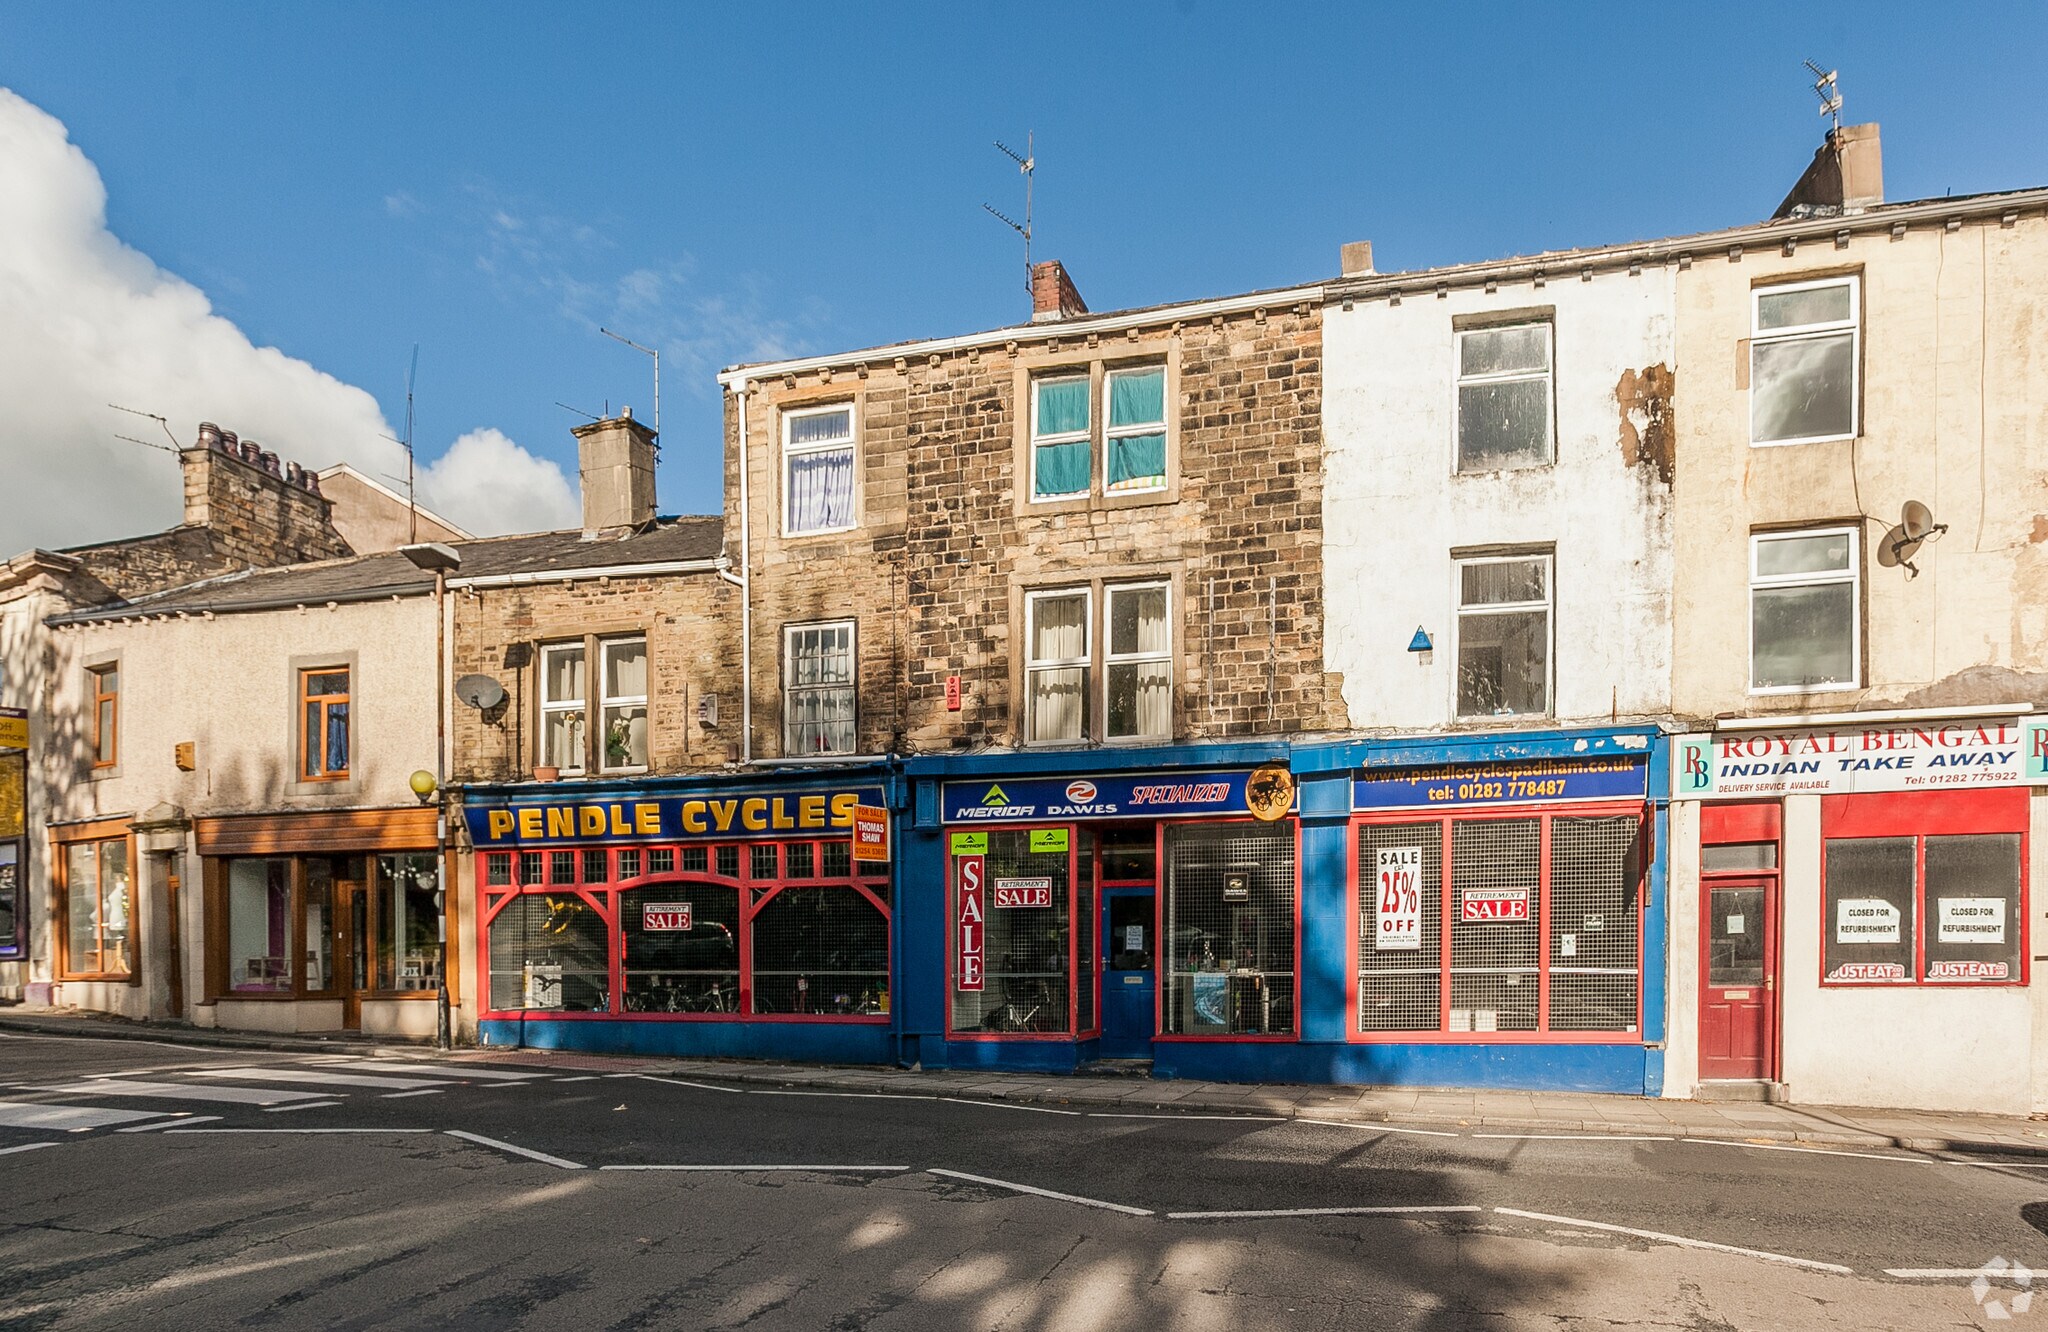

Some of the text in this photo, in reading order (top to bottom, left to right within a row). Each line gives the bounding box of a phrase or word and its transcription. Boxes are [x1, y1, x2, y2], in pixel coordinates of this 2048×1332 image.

[1720, 722, 2020, 758] ROYAL BENGAL
[1365, 756, 1635, 786] www.pendlecyclespadiham.co.uk
[1720, 751, 2017, 778] INDIAN TAKE AWAY
[1904, 772, 2018, 784] Tel: 01282 775922
[1428, 780, 1566, 800] tel: 01282 778487
[1718, 780, 1830, 793] DELIVERY SERVICE AVAILABLE
[1129, 782, 1230, 805] SPECIALIZED
[858, 807, 884, 818] FOR SALE
[956, 806, 1036, 818] MERIDA
[1047, 804, 1118, 815] DAWES
[488, 793, 859, 840] PENDLE CYCLES
[858, 821, 884, 834] THOMAS
[862, 832, 880, 843] SHAW
[1380, 852, 1418, 865] SALE
[998, 889, 1048, 906] SALE
[1381, 870, 1417, 914] 25%
[1466, 901, 1525, 919] SALE
[646, 914, 689, 928] SALE
[960, 861, 982, 985] SALE
[1383, 919, 1414, 932] OFF
[1943, 924, 2002, 933] REFURBISHMENT
[1868, 966, 1893, 978] EAT
[1932, 964, 1967, 976] JUST
[1969, 964, 1996, 976] EAT
